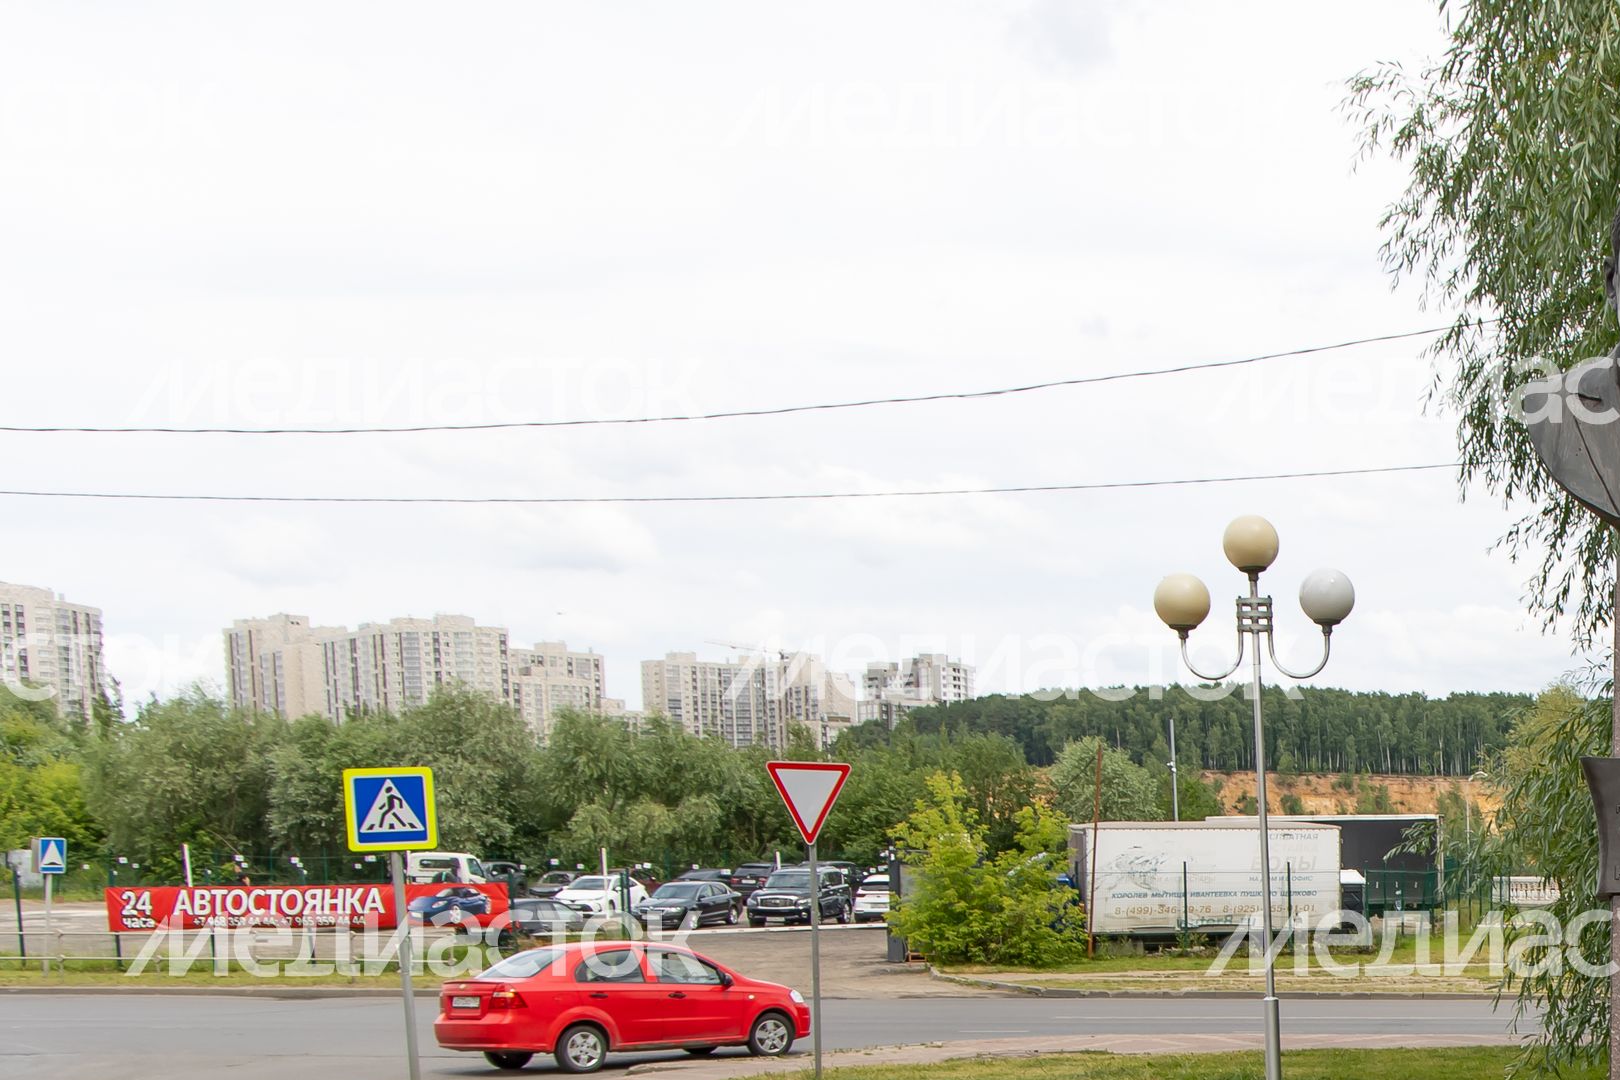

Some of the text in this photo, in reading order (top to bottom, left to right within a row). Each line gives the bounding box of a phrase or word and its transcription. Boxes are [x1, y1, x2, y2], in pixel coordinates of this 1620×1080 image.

[121, 889, 152, 916] 24
[173, 887, 386, 917] АВТОСТОЯНКА
[1115, 905, 1212, 915] 8-(499)-346-9-76
[122, 915, 155, 929] часа
